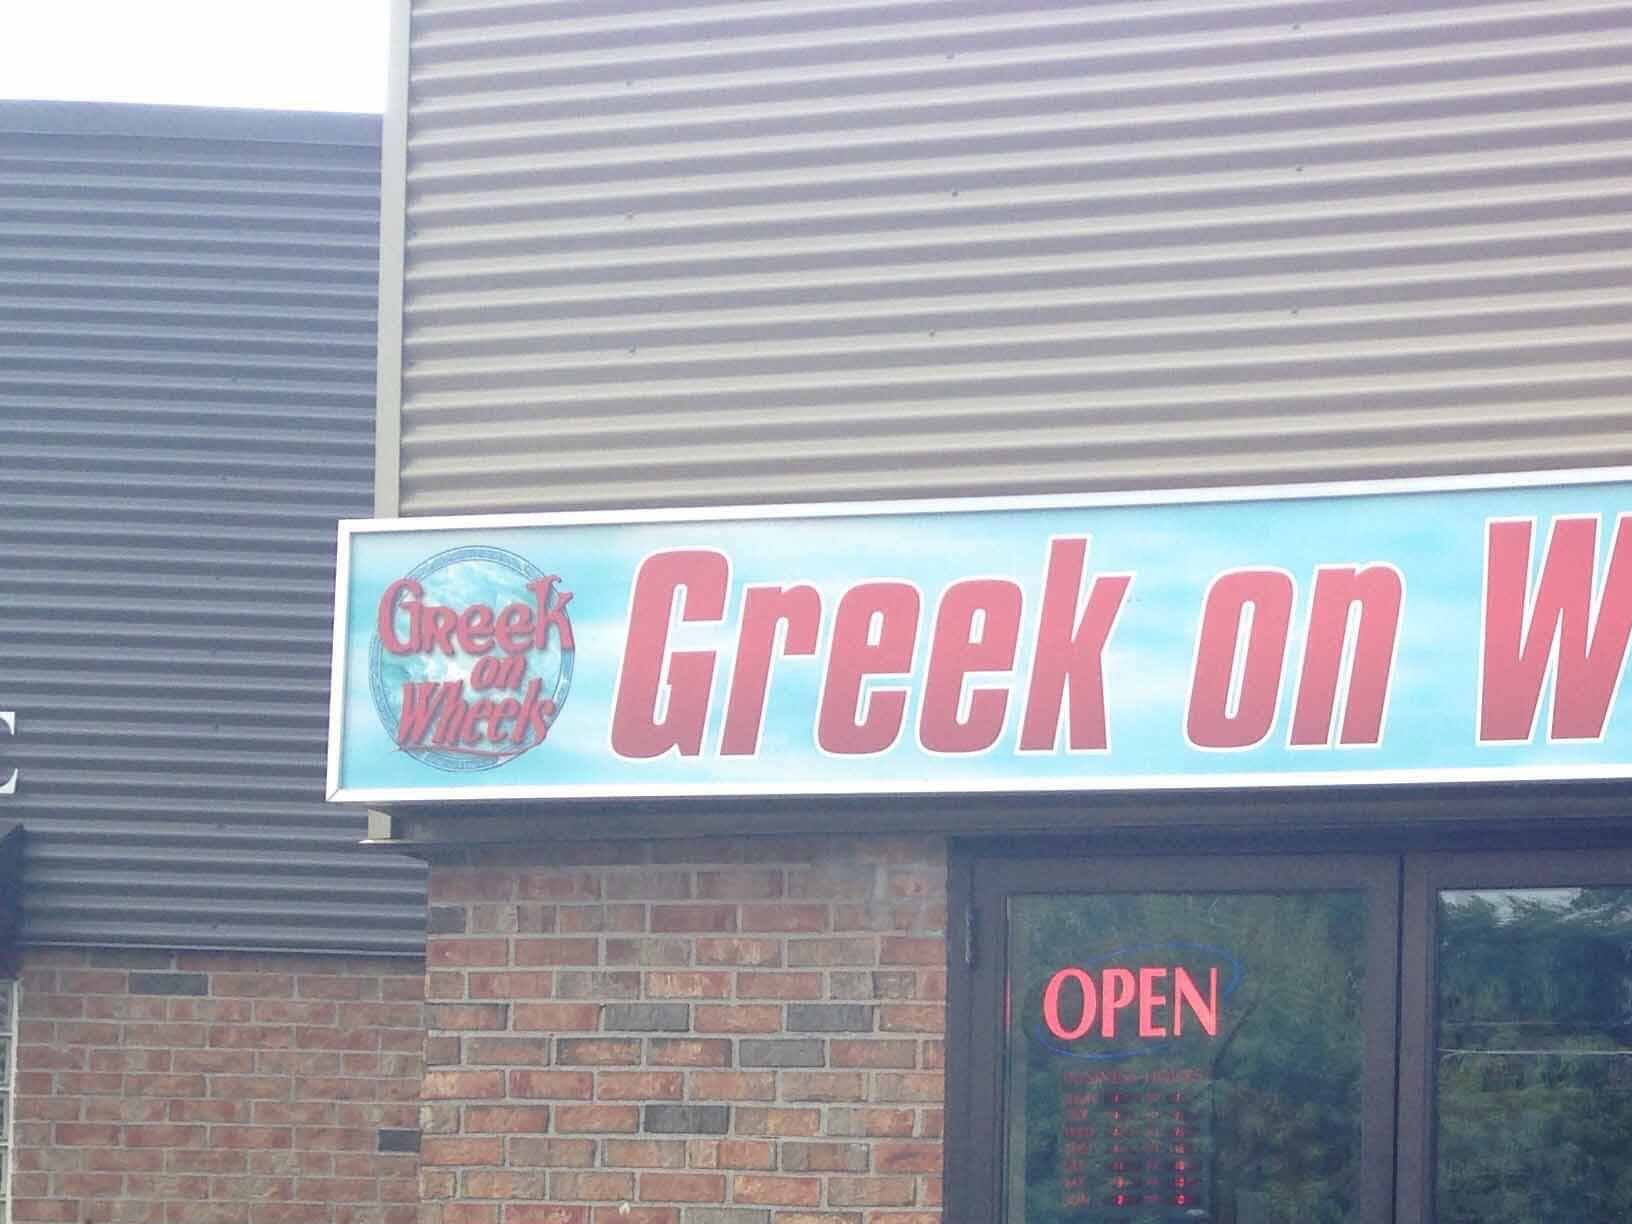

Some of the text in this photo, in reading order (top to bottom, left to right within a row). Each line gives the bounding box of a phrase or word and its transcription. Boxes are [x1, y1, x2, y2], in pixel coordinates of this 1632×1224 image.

[470, 656, 527, 690] on
[614, 537, 1130, 756] Greek
[1188, 566, 1403, 748] on
[397, 678, 556, 747] Wheels
[1042, 965, 1218, 1041] OPEN
